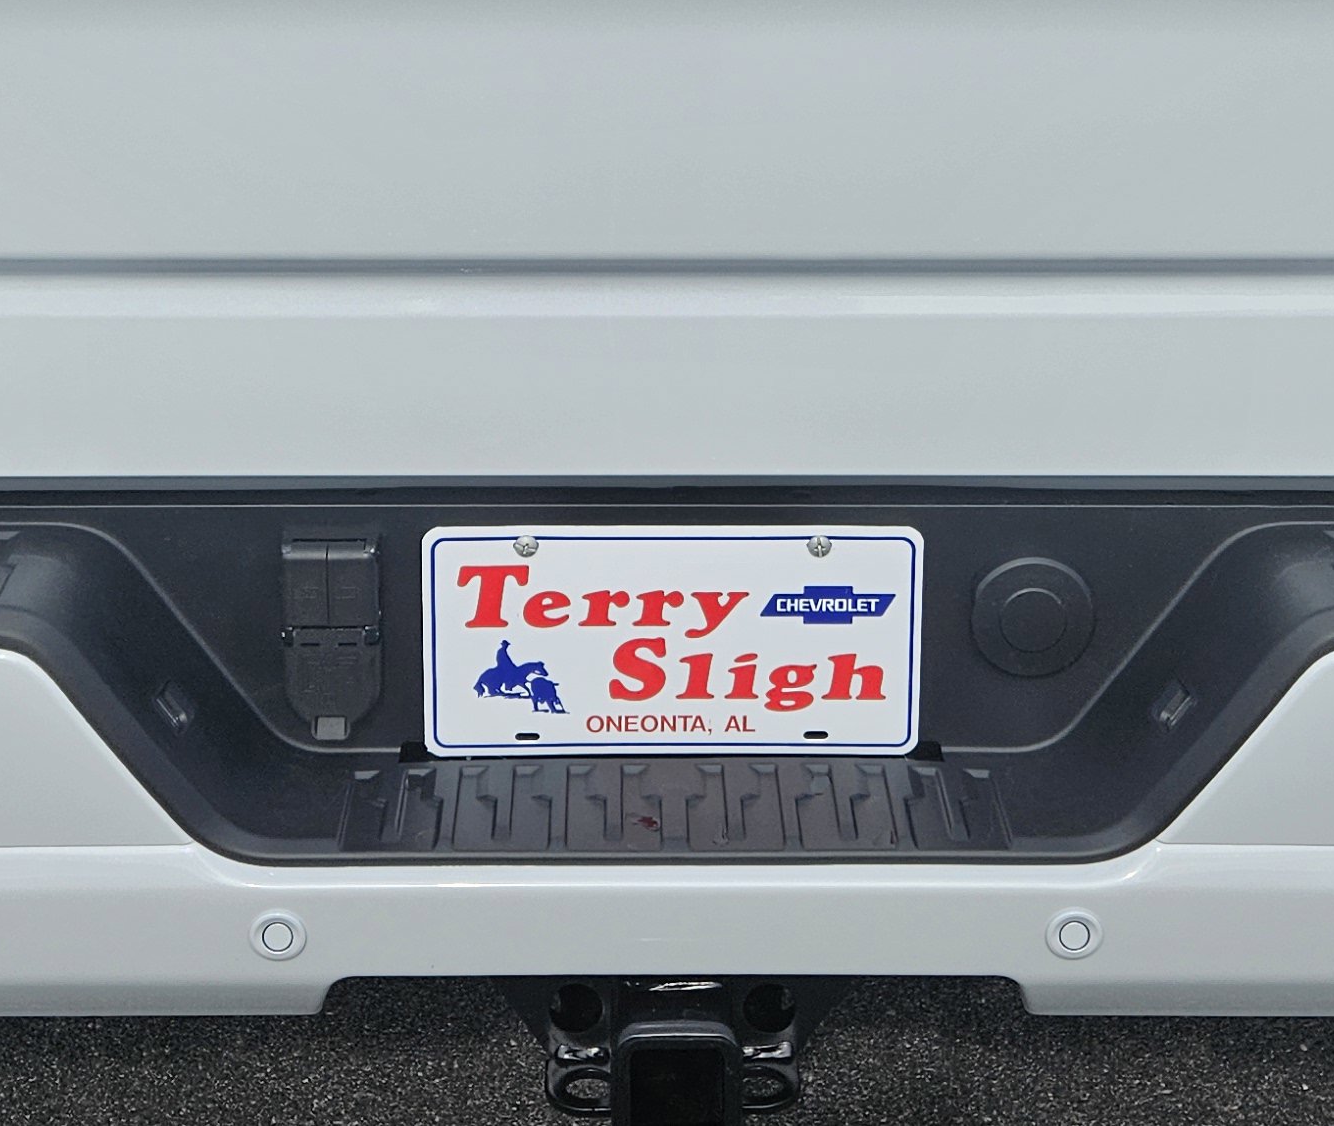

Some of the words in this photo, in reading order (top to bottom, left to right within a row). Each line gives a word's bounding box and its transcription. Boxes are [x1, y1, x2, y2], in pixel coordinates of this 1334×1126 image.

[457, 564, 750, 639] Terry
[774, 596, 881, 615] CHEVROLET
[608, 637, 887, 712] Sligh
[585, 715, 713, 735] ONEONTA,
[724, 715, 755, 733] AL
